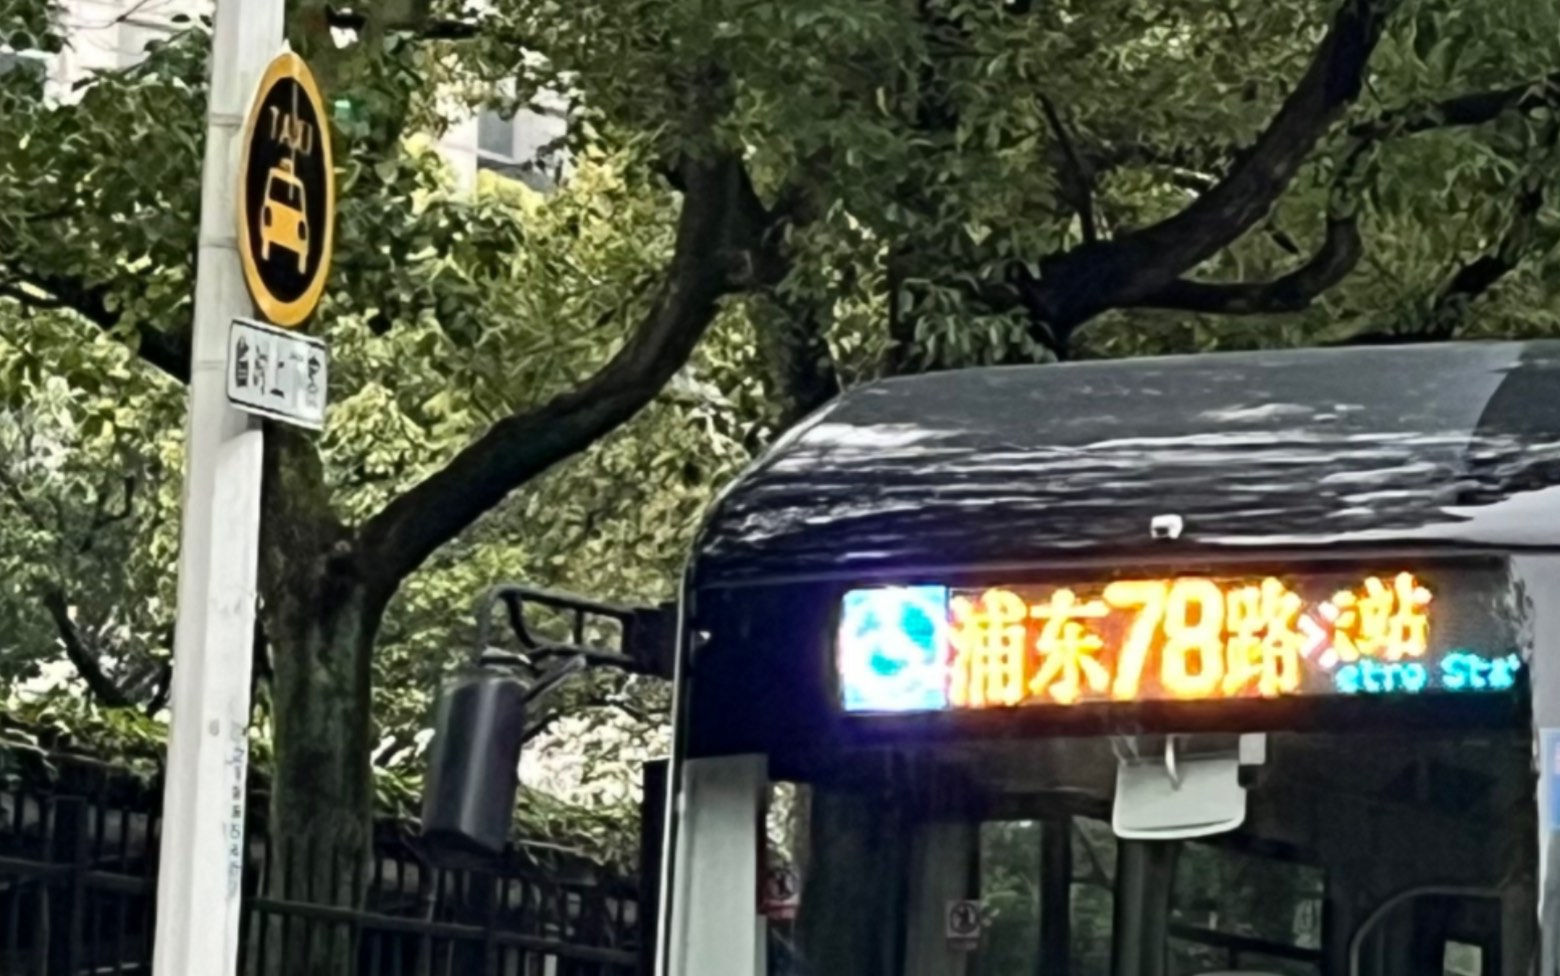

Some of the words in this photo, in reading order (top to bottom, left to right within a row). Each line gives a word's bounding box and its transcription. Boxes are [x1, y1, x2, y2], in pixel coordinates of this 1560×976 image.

[270, 105, 313, 157] TAXI
[949, 576, 1302, 706] 浦东78路
